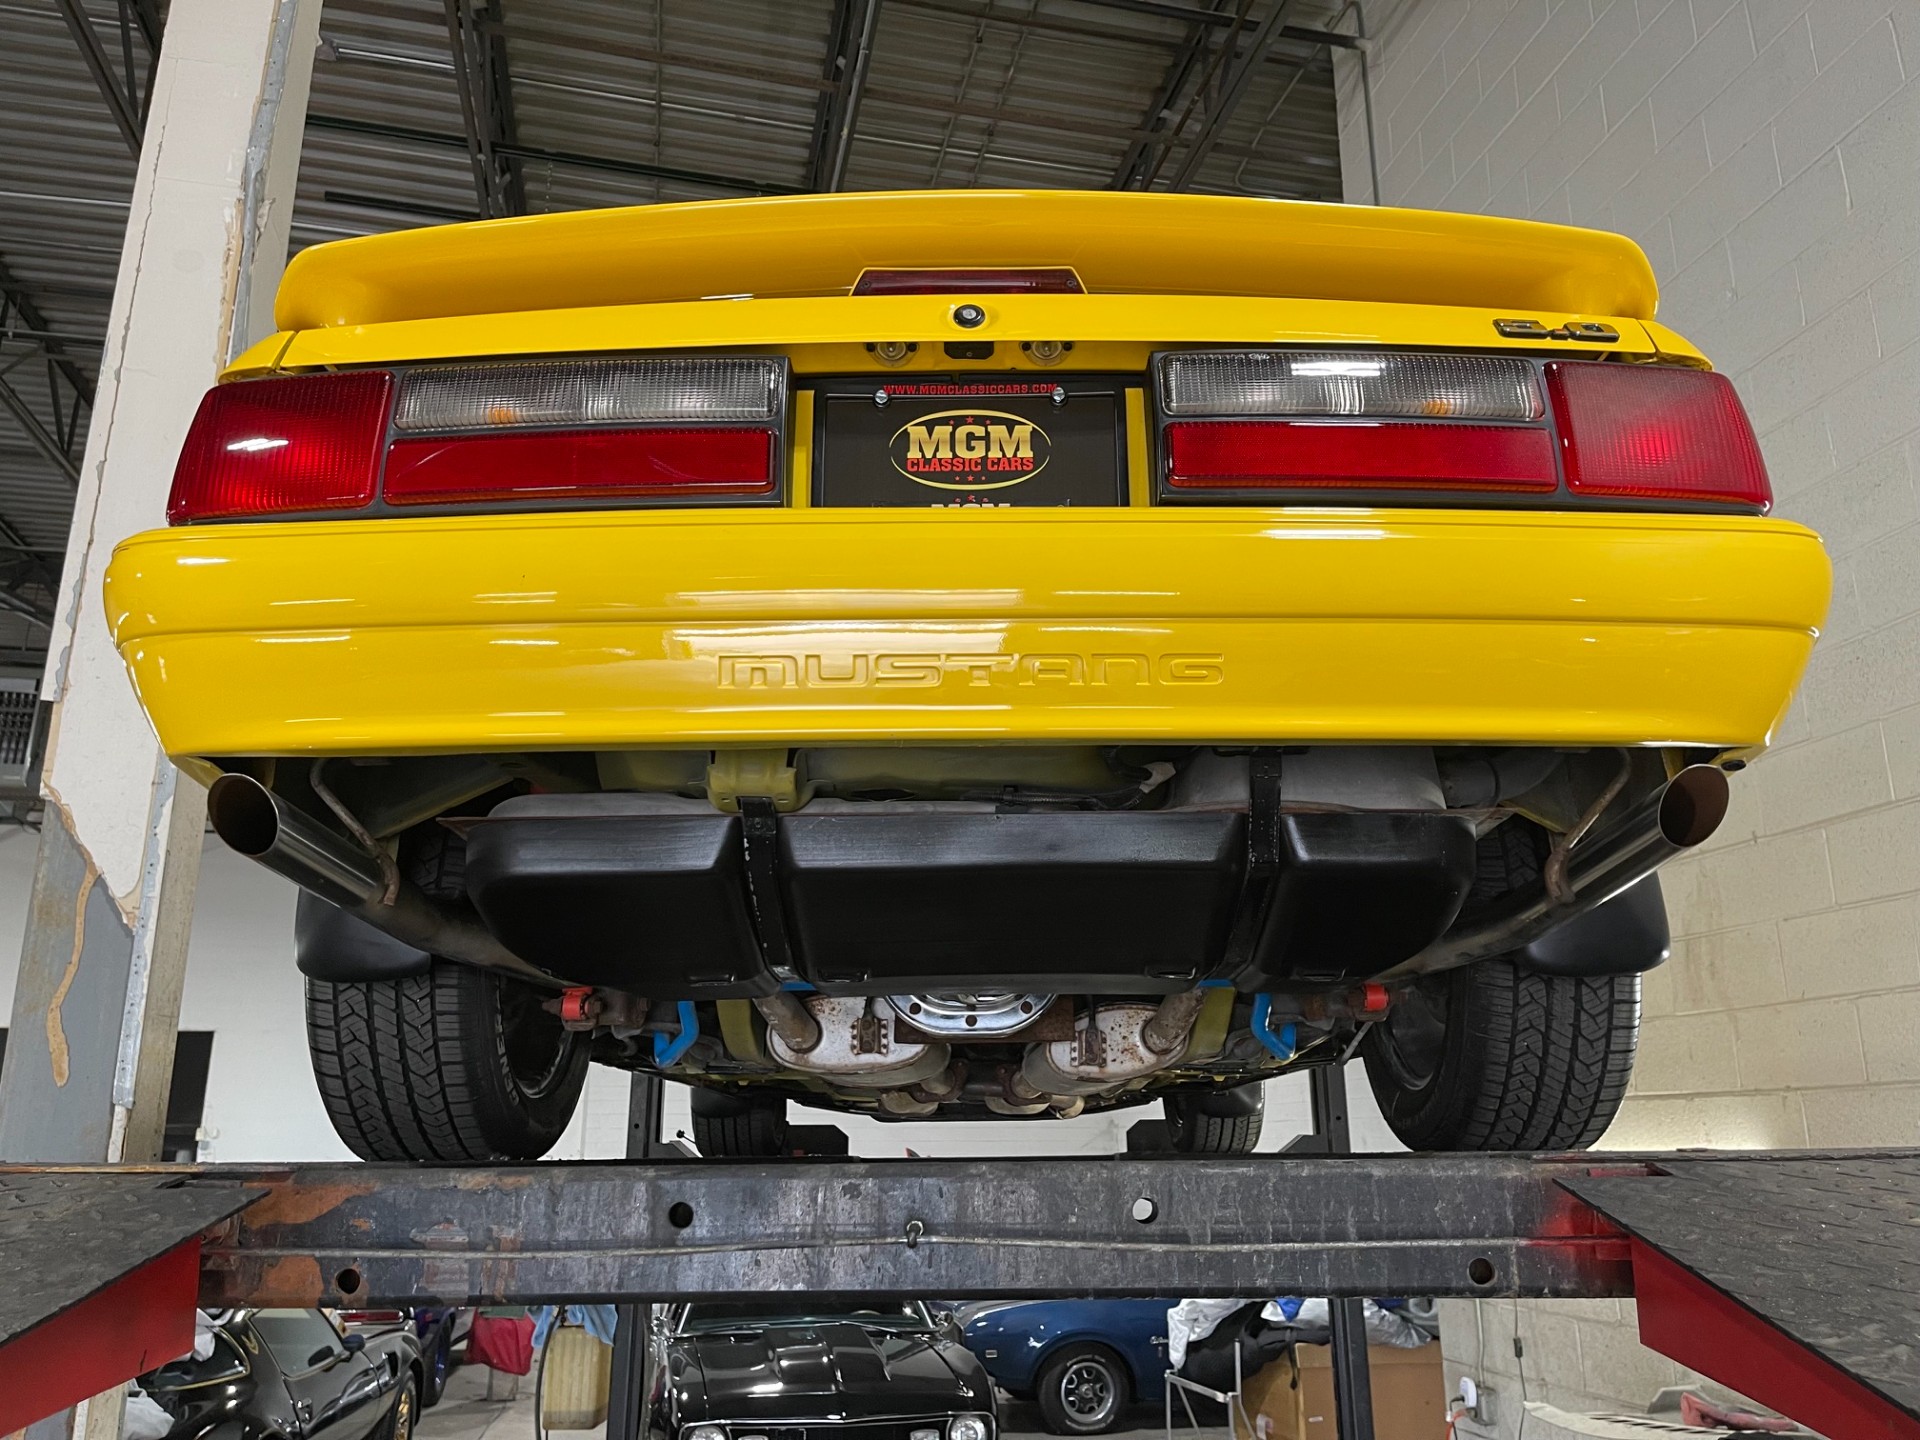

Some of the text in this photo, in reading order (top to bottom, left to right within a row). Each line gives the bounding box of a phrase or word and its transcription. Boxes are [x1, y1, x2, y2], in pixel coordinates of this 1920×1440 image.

[883, 383, 1058, 395] WWW.MGMCLASSICCARS.COM
[907, 425, 1034, 458] MGM
[907, 457, 1034, 472] CLASSIC CARS
[716, 653, 1225, 690] MUSTANG
[494, 975, 520, 1106] GENER
